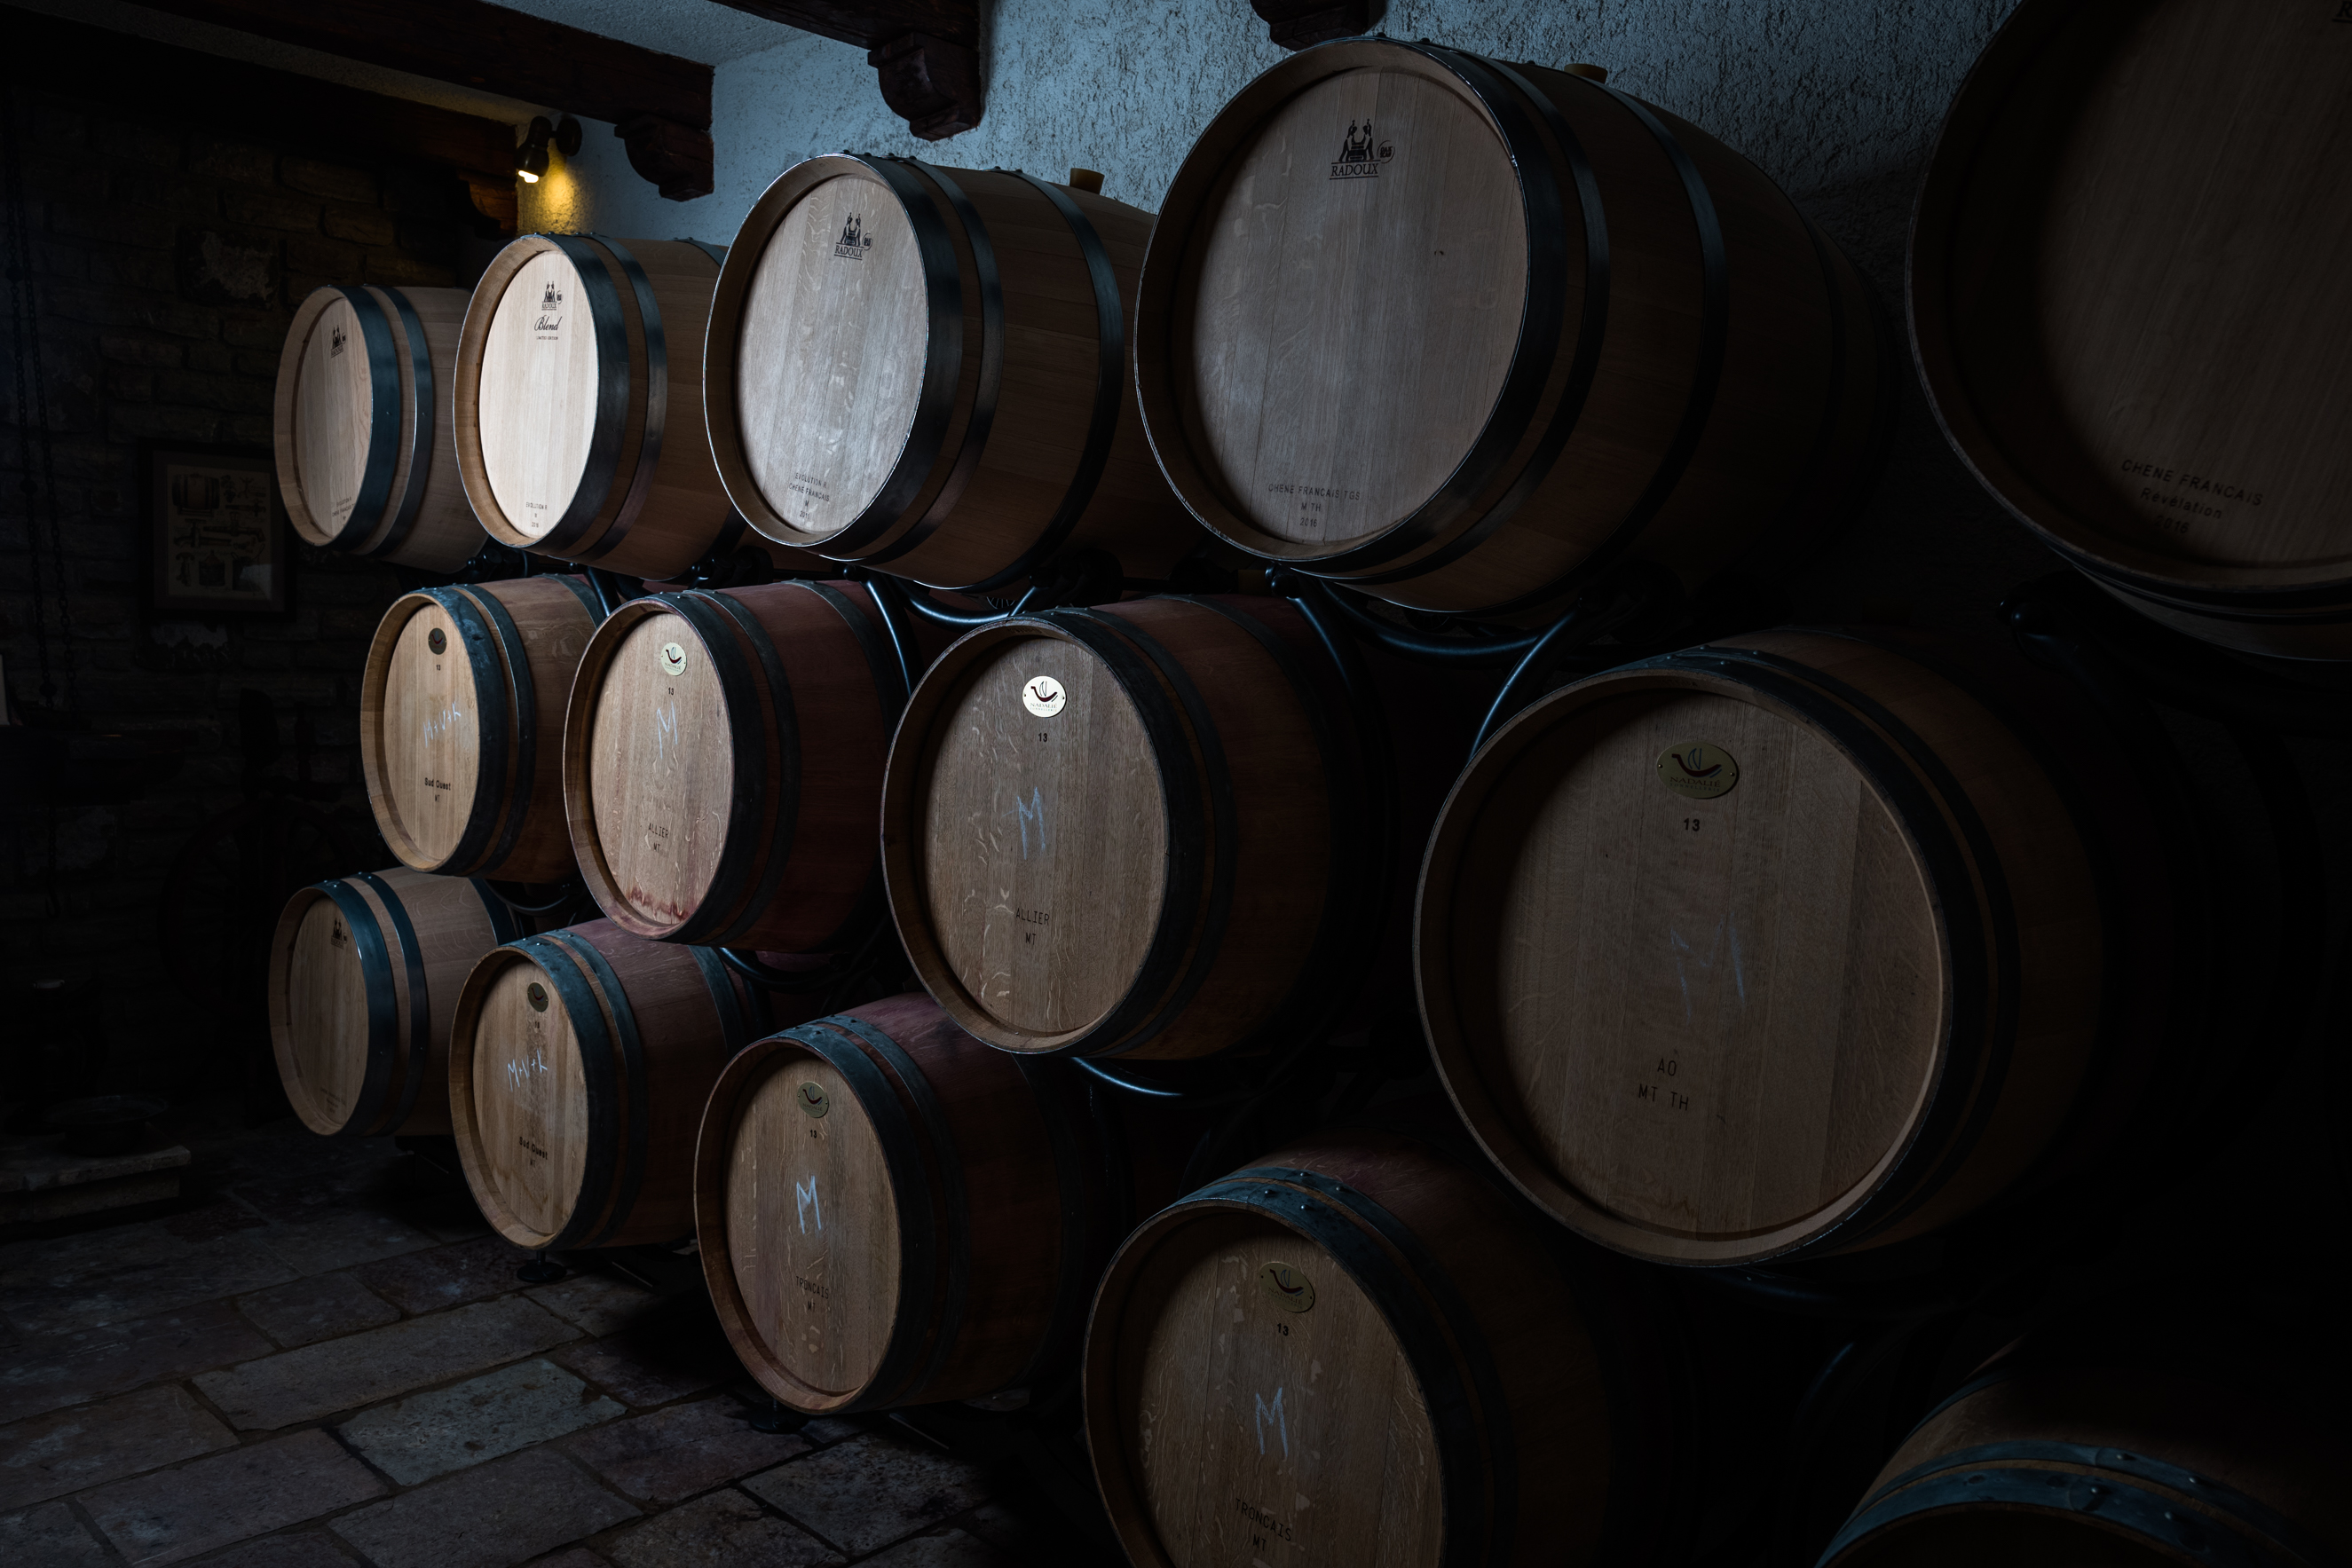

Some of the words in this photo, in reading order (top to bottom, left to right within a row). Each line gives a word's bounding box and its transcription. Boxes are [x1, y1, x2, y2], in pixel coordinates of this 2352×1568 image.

[1330, 163, 1379, 177] RADOUX
[835, 245, 864, 258] RADOUX
[533, 314, 563, 331] Blend
[794, 472, 822, 486] EVOLUTION
[2121, 459, 2174, 482] CHENE
[2179, 474, 2263, 506] FRANCAIS
[788, 482, 804, 493] CHENE
[805, 487, 830, 502] FRANCAIS
[1268, 483, 1295, 494] CHENE
[1298, 485, 1340, 499] FRANCAIS
[1344, 490, 1361, 500] TGS
[1300, 502, 1307, 511] M
[1310, 502, 1322, 512] TH
[2140, 487, 2222, 519] Révélation
[1299, 517, 1318, 528] 2016
[2154, 515, 2190, 534] 2016
[668, 687, 675, 696] 13
[656, 699, 678, 760] M
[1038, 732, 1048, 743] 13
[424, 776, 434, 787] Sud
[436, 779, 451, 791] Ouest
[1669, 776, 1721, 788] NADALIÉ
[1669, 783, 1720, 792] TONNELLERIE
[434, 794, 440, 803] MT
[648, 822, 669, 839] ALLIER
[1015, 785, 1046, 861] M
[1684, 817, 1701, 832] 13
[653, 842, 660, 854] MT
[1015, 907, 1050, 926] ALLIER
[1025, 932, 1037, 946] MT
[1657, 1058, 1677, 1076] AO
[1638, 1083, 1659, 1102] MT
[1670, 1091, 1689, 1111] TH
[809, 1129, 817, 1139] 13
[531, 1143, 548, 1161] Ouest
[795, 1175, 822, 1236] M
[795, 1275, 829, 1300] TRONCAIS
[1267, 1287, 1303, 1305] NADALIÉ
[808, 1300, 816, 1313] MT
[1276, 1322, 1289, 1336] 13
[1255, 1386, 1289, 1458] M
[1235, 1497, 1291, 1542] TRONCAIS
[1252, 1533, 1267, 1552] MT
